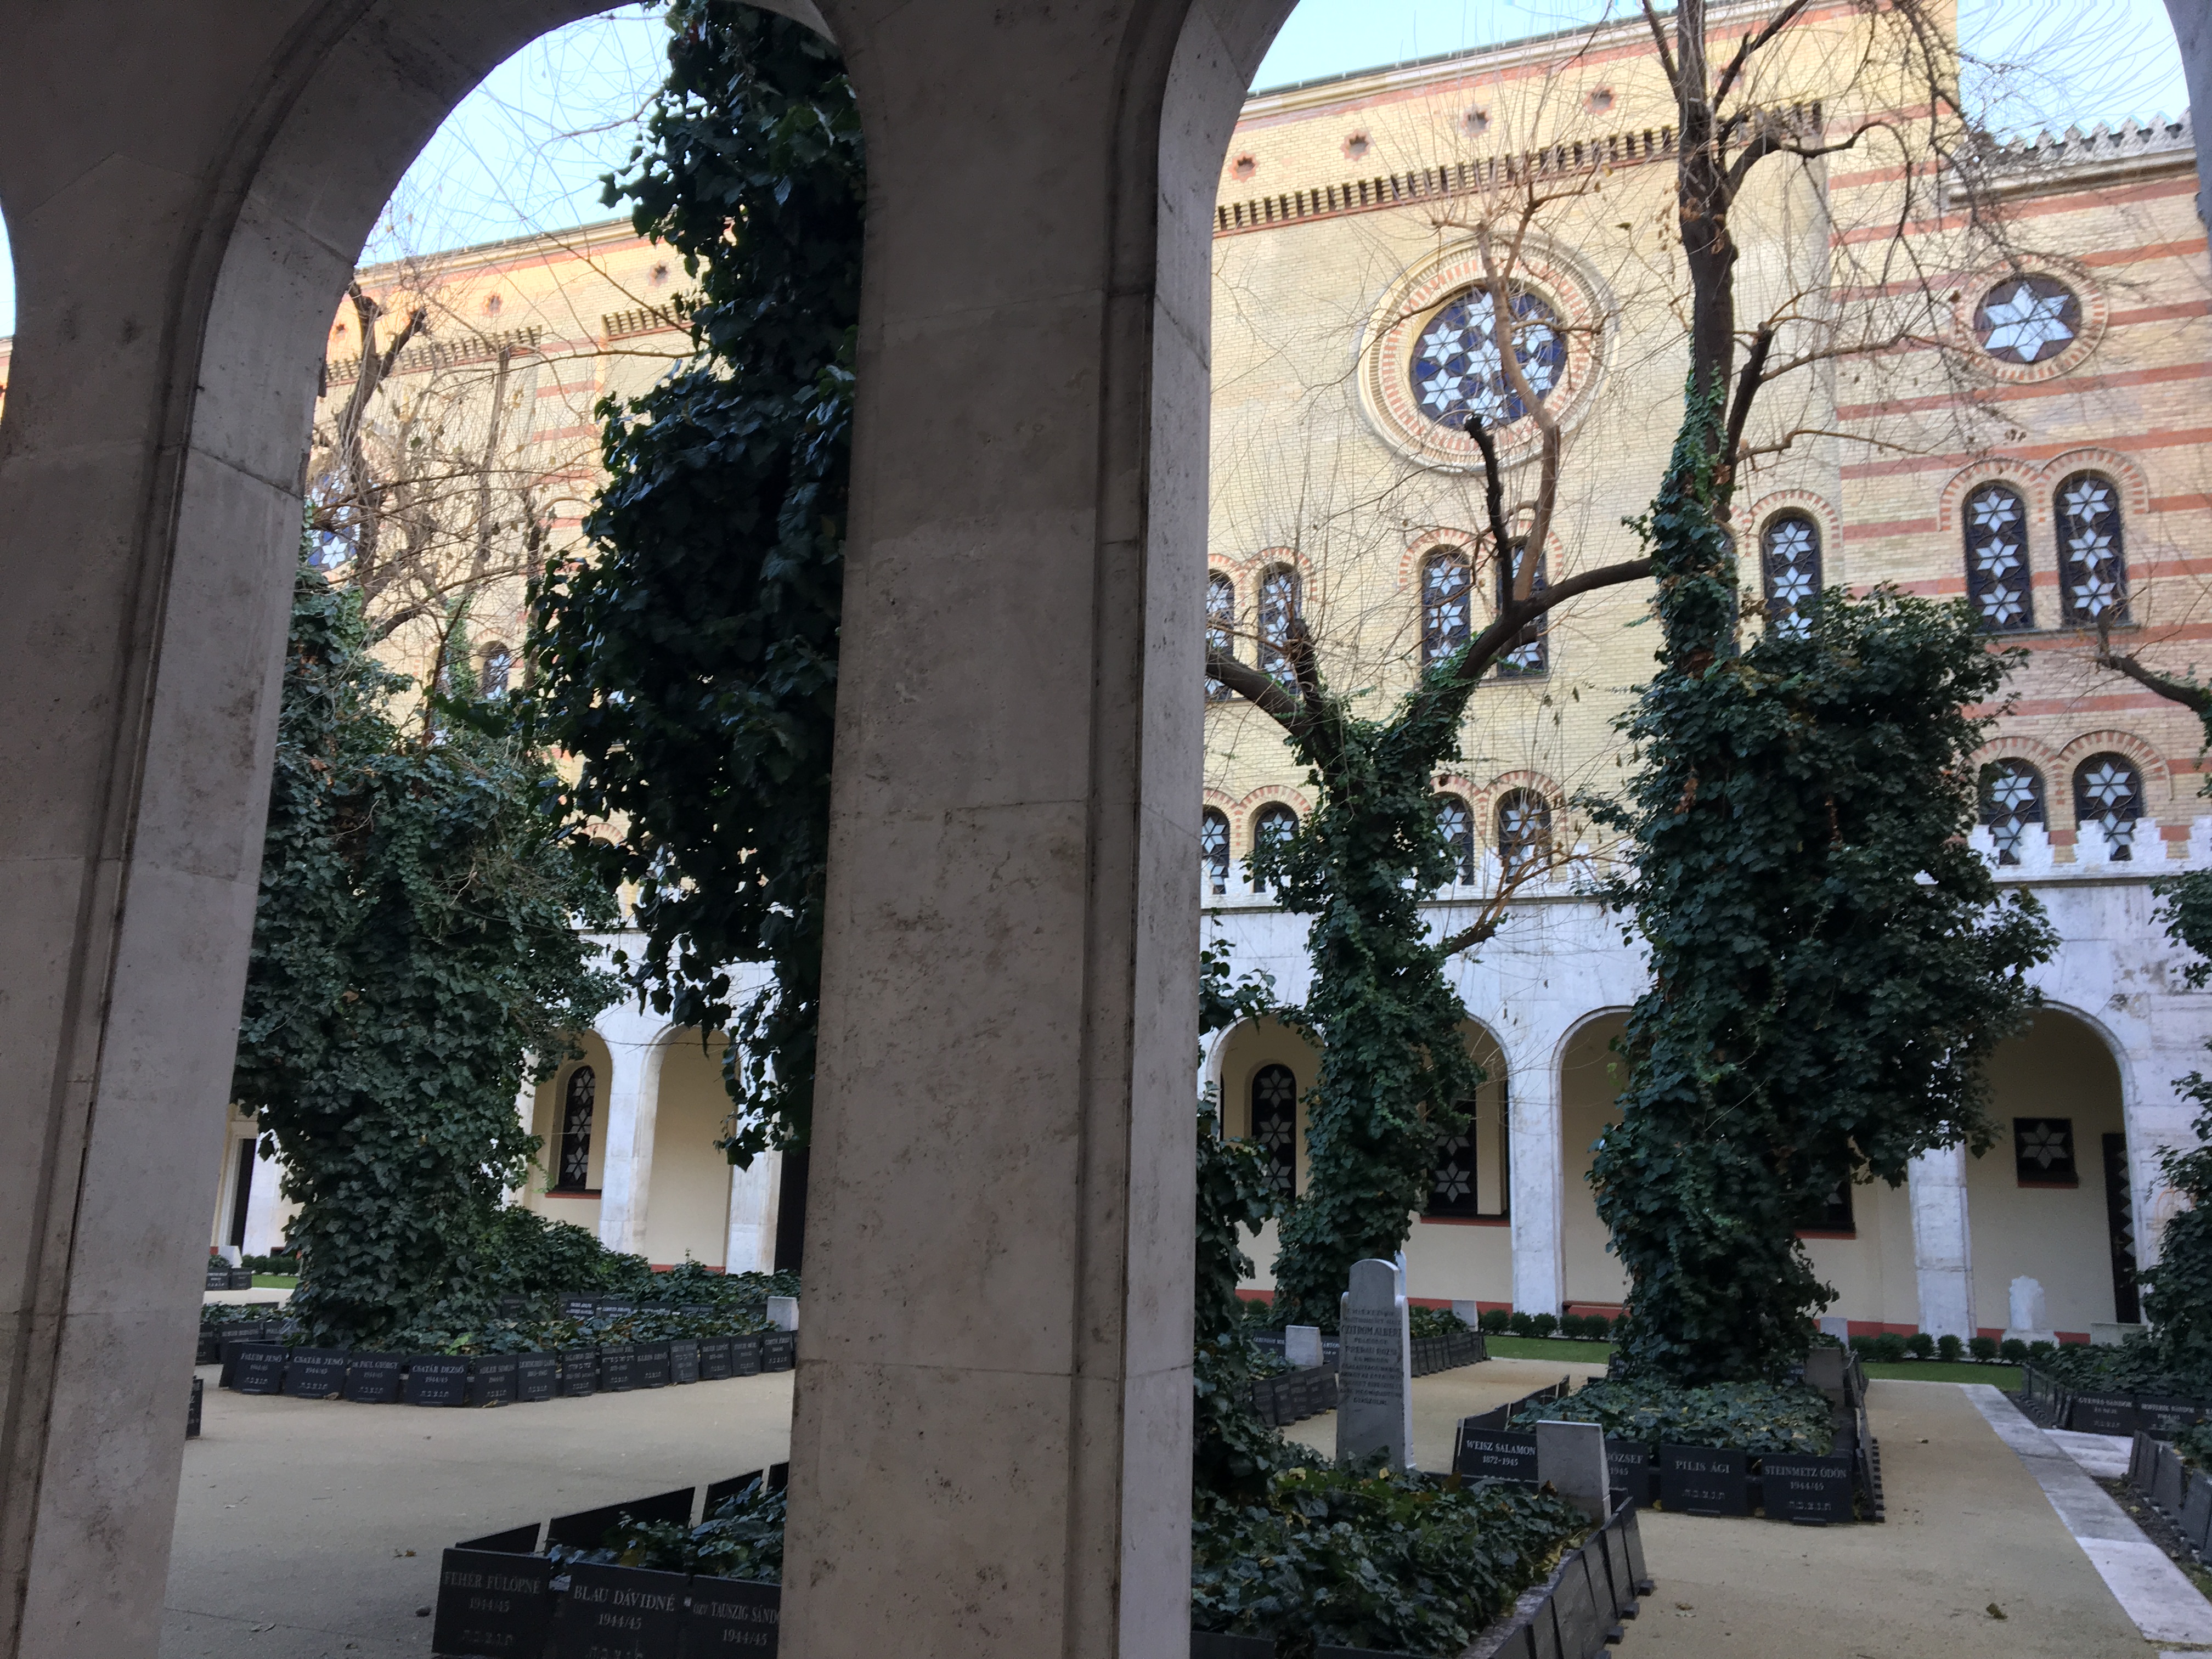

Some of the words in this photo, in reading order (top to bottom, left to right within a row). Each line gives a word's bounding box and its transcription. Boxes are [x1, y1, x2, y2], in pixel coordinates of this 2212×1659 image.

[294, 1356, 321, 1365] CSATÁR
[323, 1357, 343, 1365] JENŐ
[412, 1364, 438, 1373] CSATÁR
[441, 1364, 464, 1374] DEZSŐ
[1466, 1439, 1493, 1451] WEISZ
[1495, 1442, 1536, 1456] SALAMON
[1482, 1455, 1519, 1466] 1872-1945
[1674, 1460, 1706, 1472] PILIS
[1709, 1460, 1731, 1474] ÁGI
[1764, 1465, 1818, 1478] STEINMETZ
[1819, 1466, 1848, 1480] ÖDÖN
[1790, 1481, 1825, 1491] 1944/45
[442, 1571, 482, 1588] FEHÉR
[574, 1585, 609, 1604] BLAU
[612, 1588, 676, 1612] DÁVIDNÉ
[711, 1601, 749, 1621] TAUSZIG
[598, 1613, 642, 1630] 1944/45
[722, 1628, 769, 1647] 1944/45
